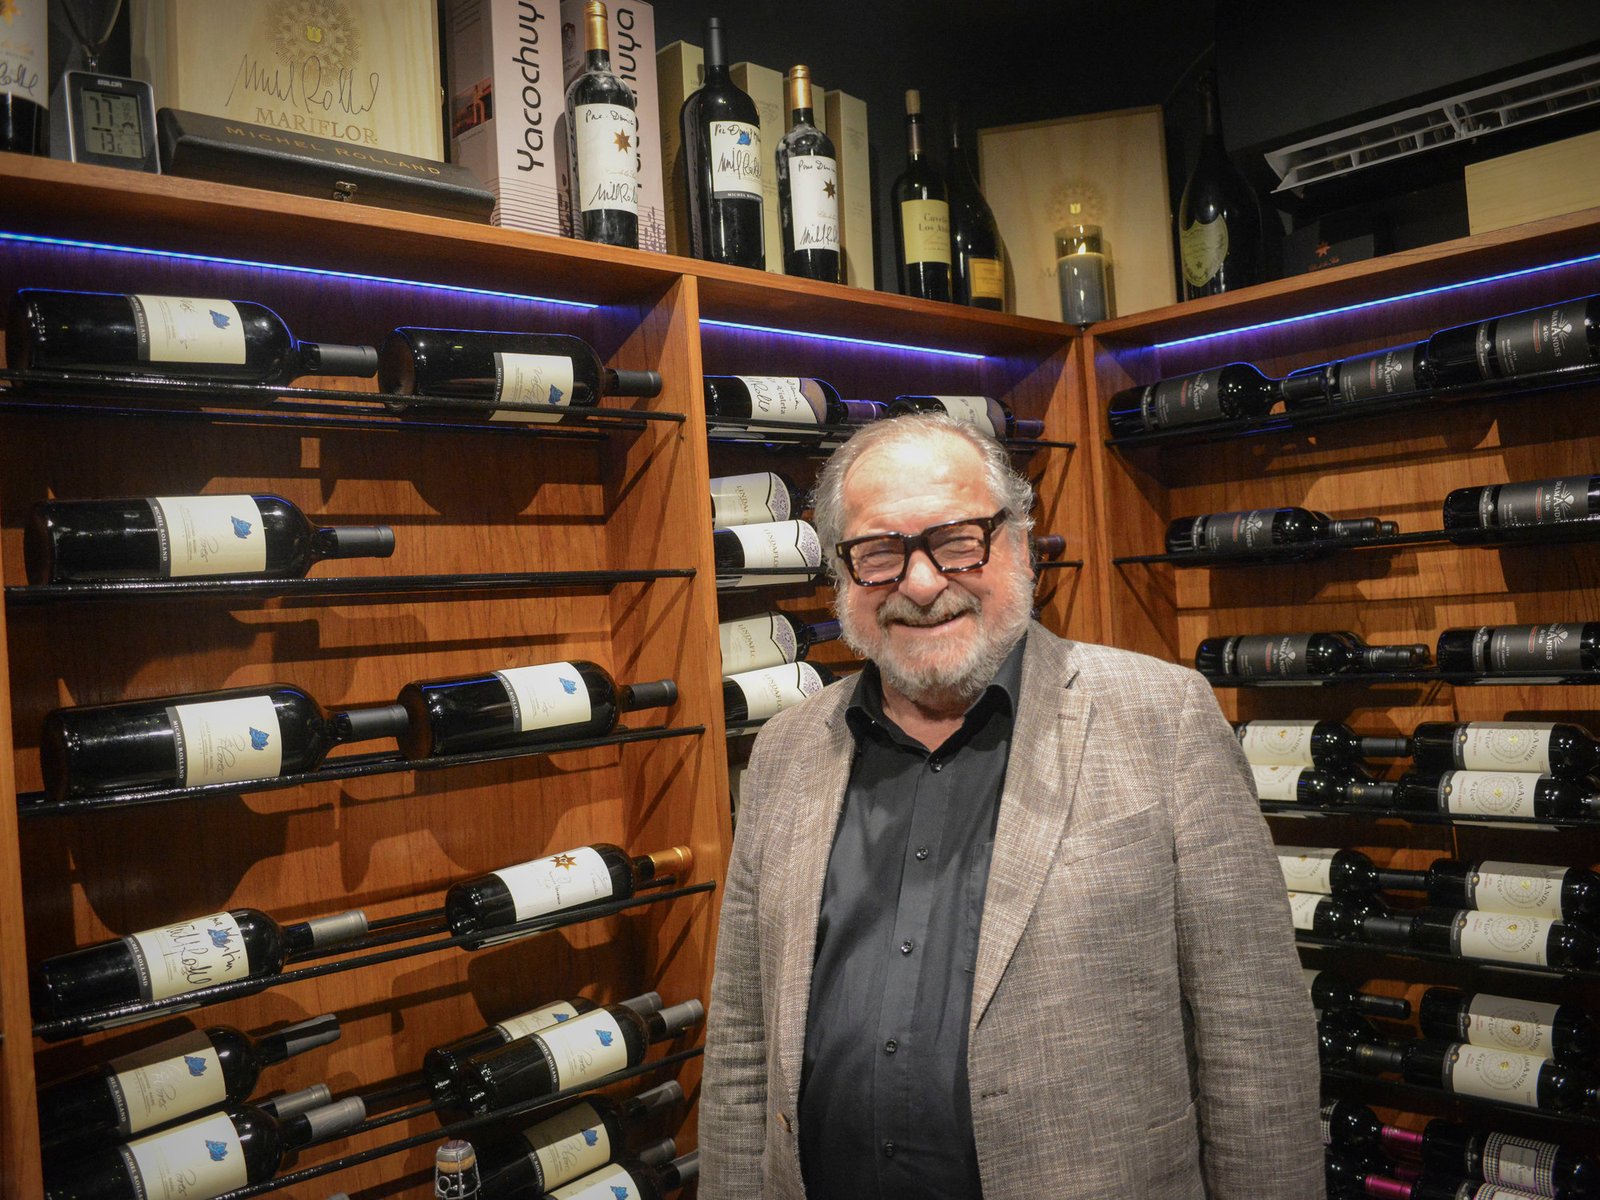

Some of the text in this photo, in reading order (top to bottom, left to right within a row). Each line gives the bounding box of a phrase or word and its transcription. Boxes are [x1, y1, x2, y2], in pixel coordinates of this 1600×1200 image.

[225, 125, 441, 176] MICHEL ROLLAND
[154, 506, 168, 562] MICHEL ROLLAND
[509, 690, 520, 719] ROLLAND
[172, 720, 182, 746] MICHEL
[136, 953, 148, 987] ROLLAND
[546, 1056, 558, 1084] ROLLAND
[113, 1087, 126, 1123] ROLLAND
[124, 1152, 137, 1174] MICHEL
